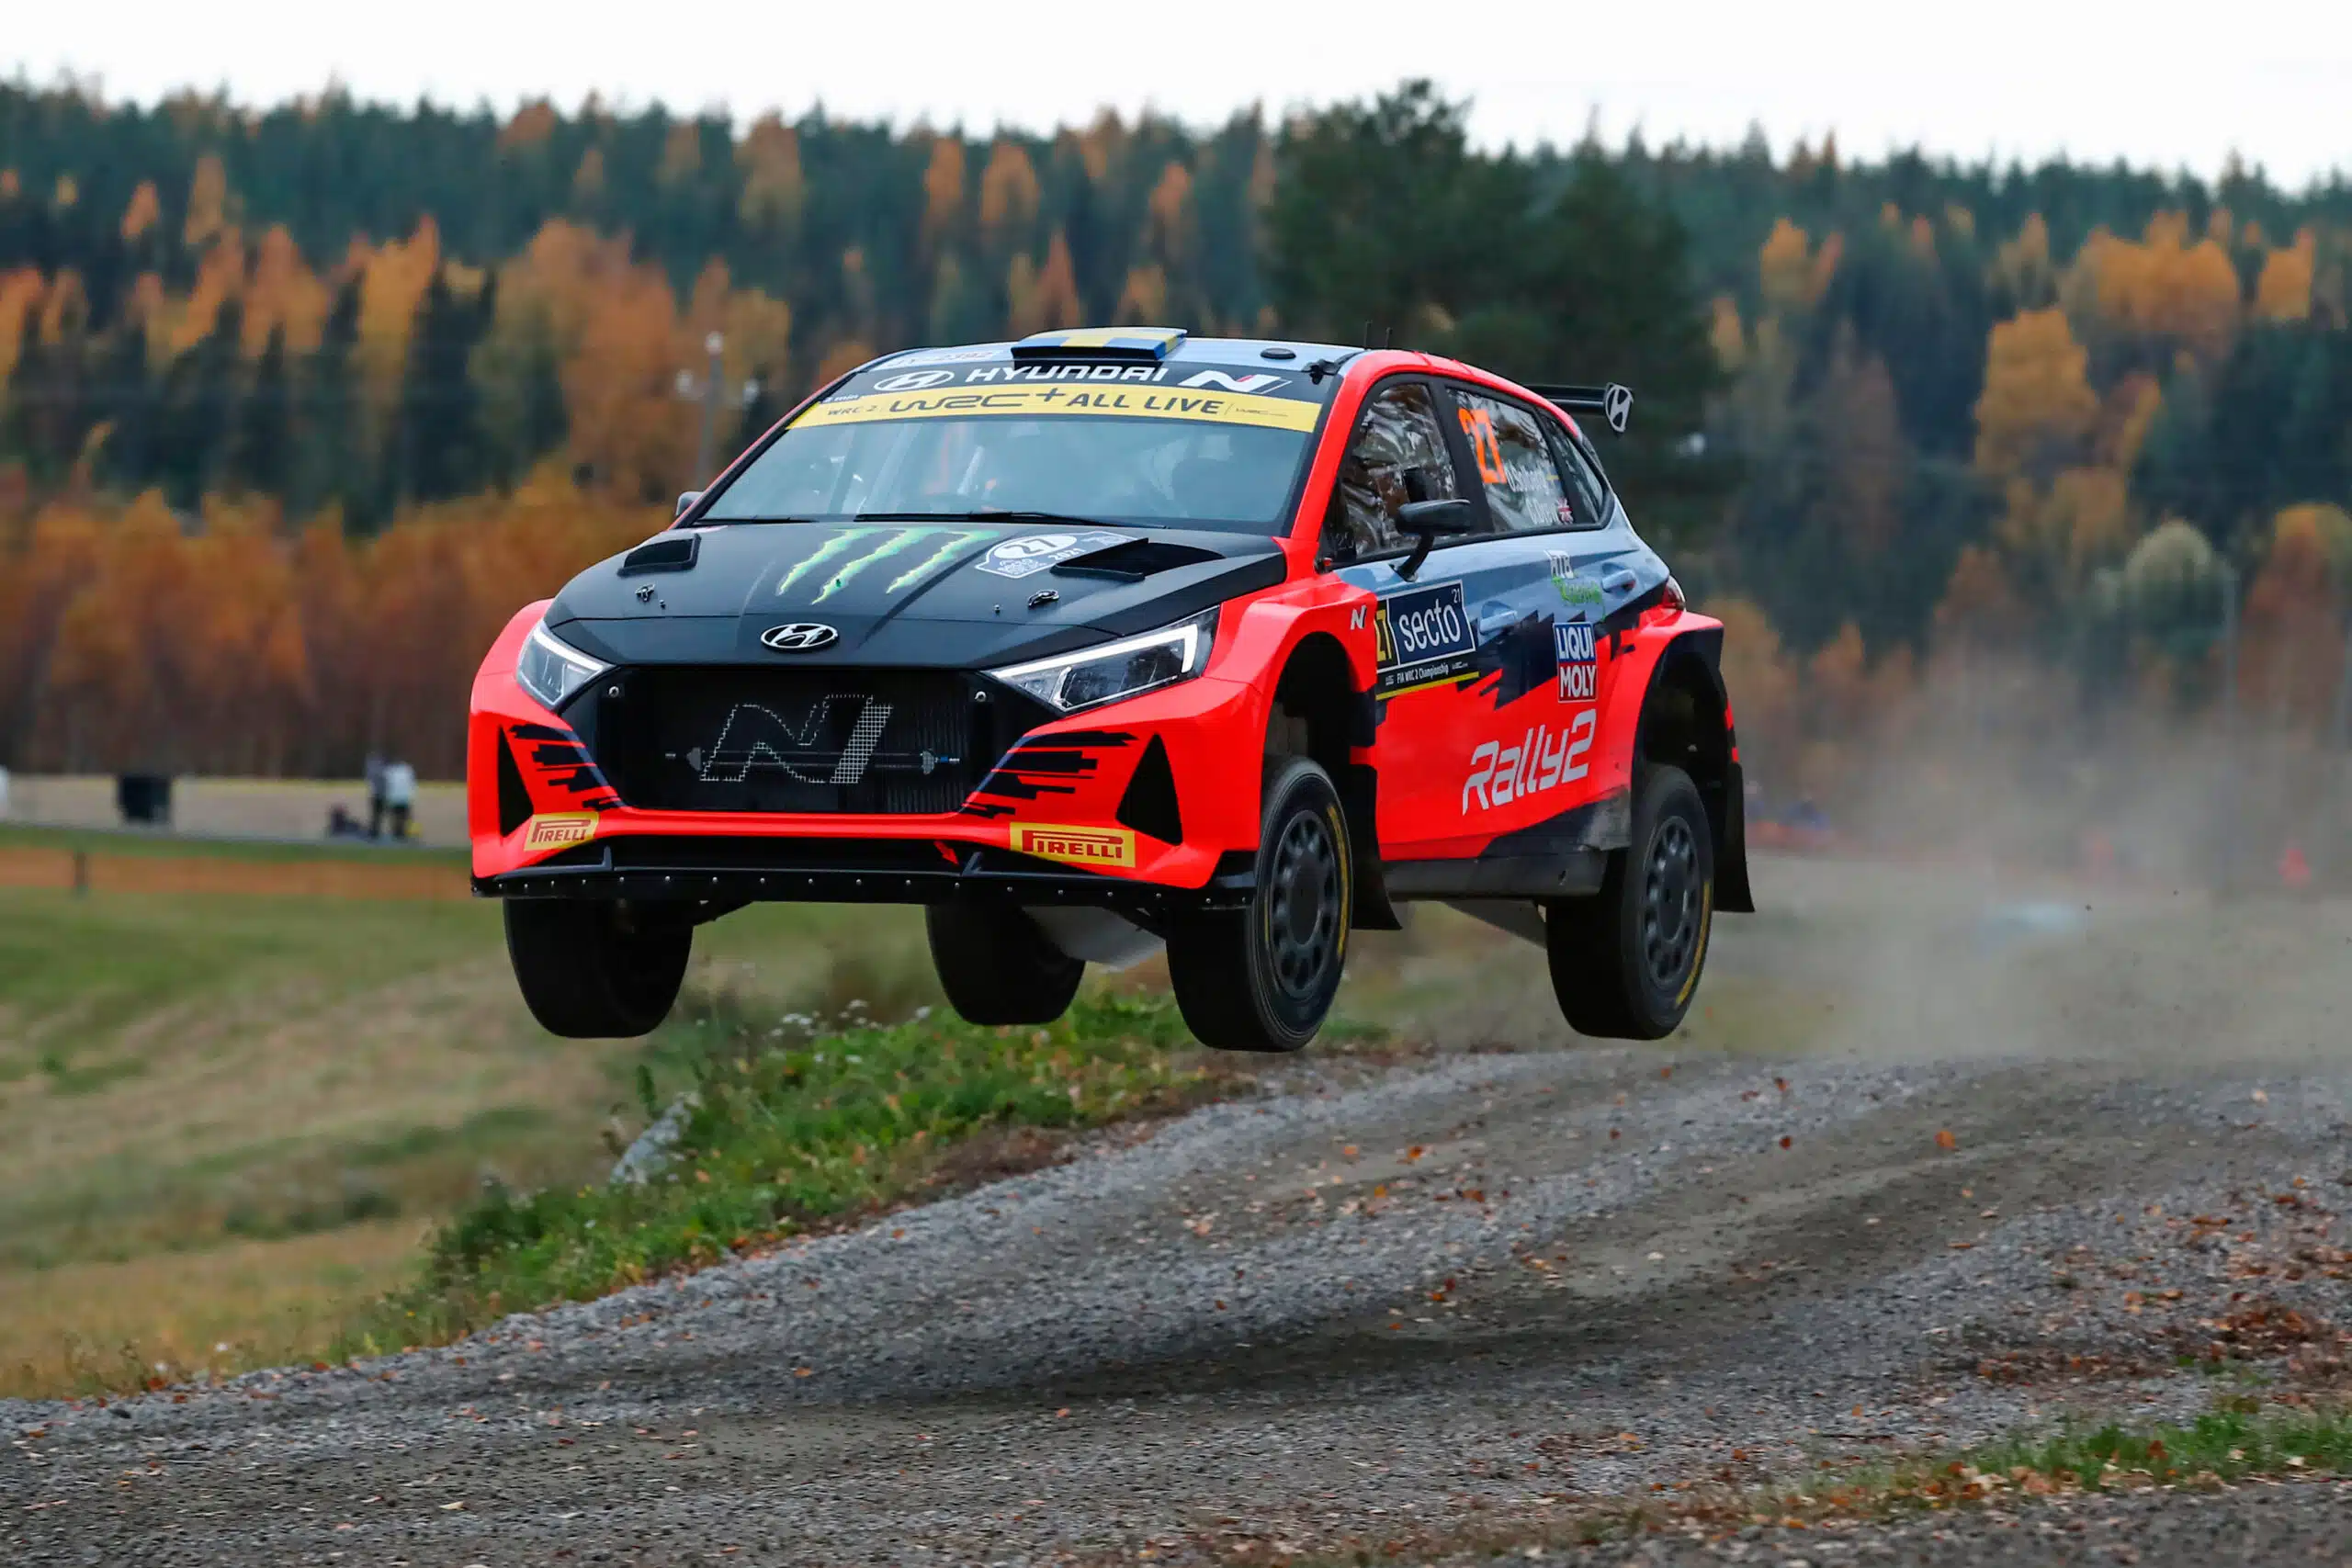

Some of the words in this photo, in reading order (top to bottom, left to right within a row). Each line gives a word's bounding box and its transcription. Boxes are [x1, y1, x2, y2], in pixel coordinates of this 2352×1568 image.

[966, 366, 1169, 382] HYUNDAI
[1066, 393, 1131, 409] ALL
[1144, 395, 1224, 414] LIVE
[1004, 538, 1057, 555] 27
[1350, 604, 1367, 630] N
[1398, 598, 1461, 653] secto
[1452, 588, 1461, 604] 21
[1555, 625, 1596, 661] LIQUI
[1559, 662, 1597, 699] MOLY
[1462, 708, 1598, 817] Rally2
[531, 818, 592, 843] PIRELLI
[1022, 829, 1125, 859] PIRELLI
